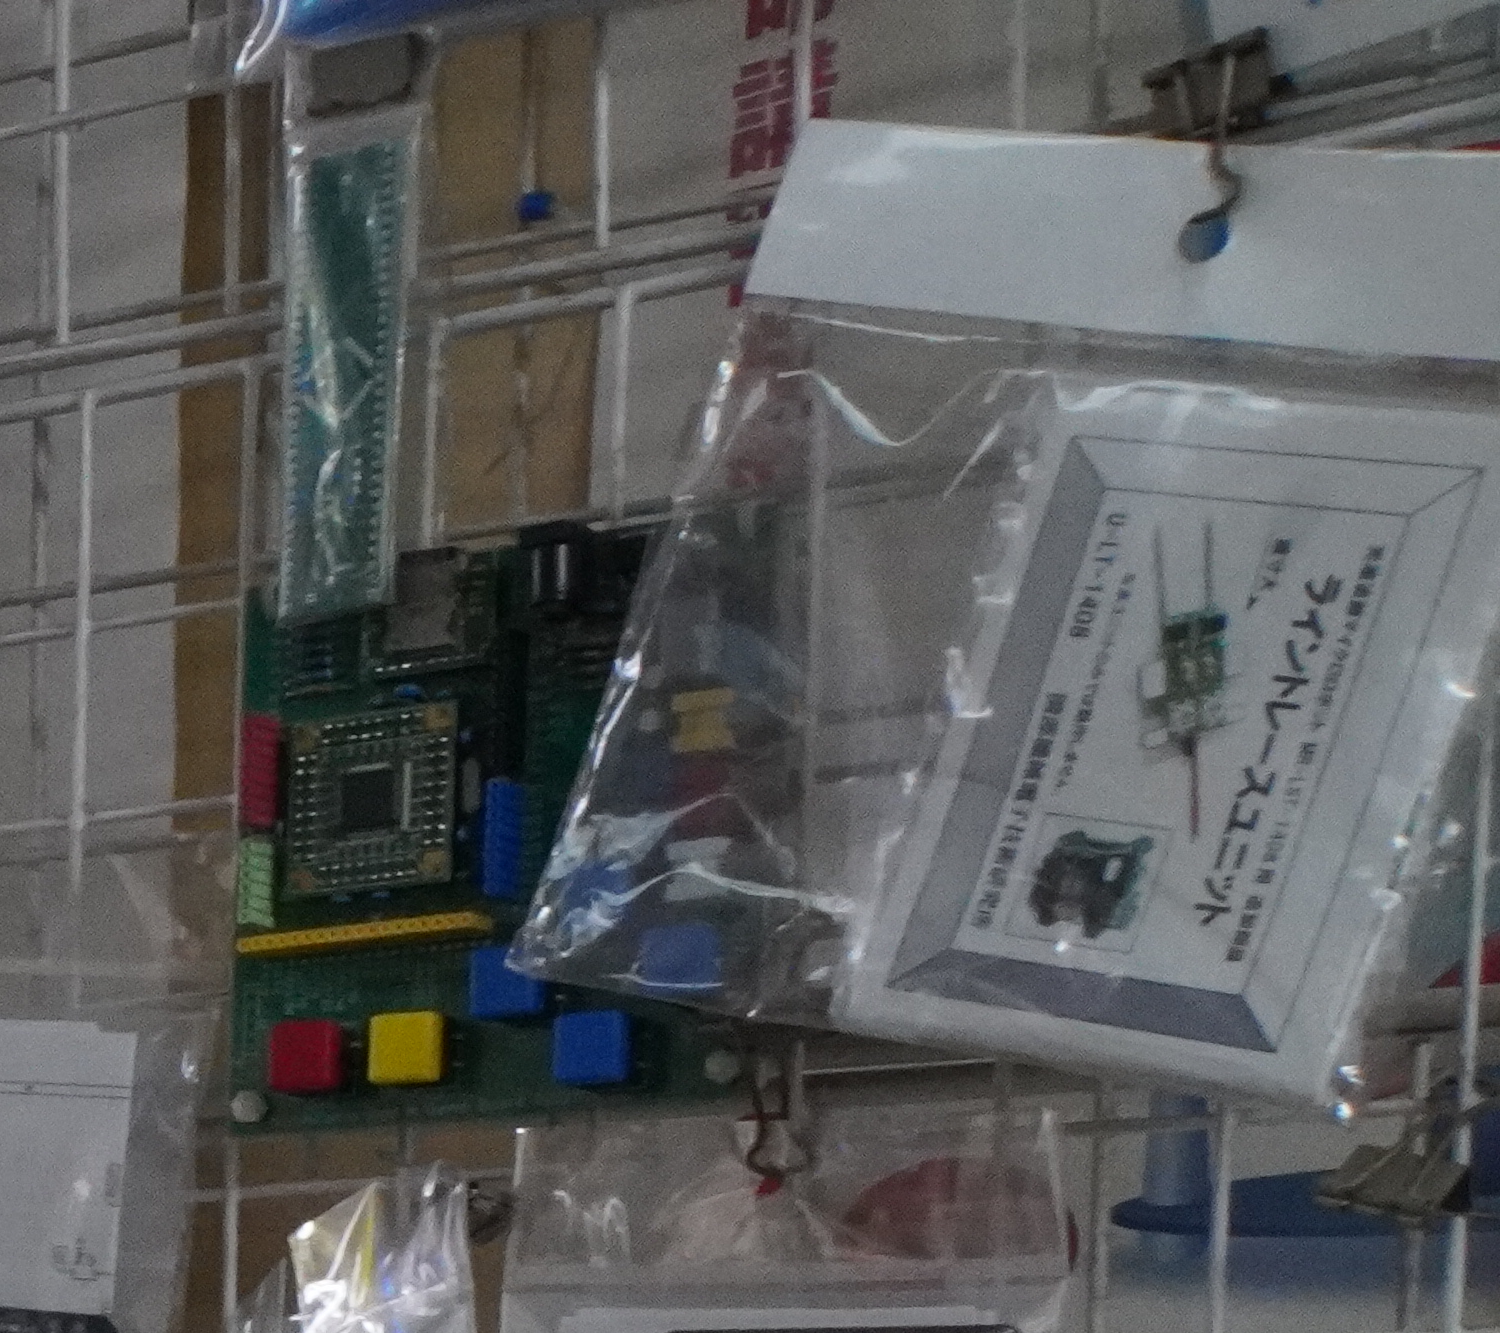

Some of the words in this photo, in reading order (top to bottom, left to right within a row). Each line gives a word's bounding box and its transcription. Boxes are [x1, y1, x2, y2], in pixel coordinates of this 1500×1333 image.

[1190, 575, 1352, 928] ライントレースユニット
